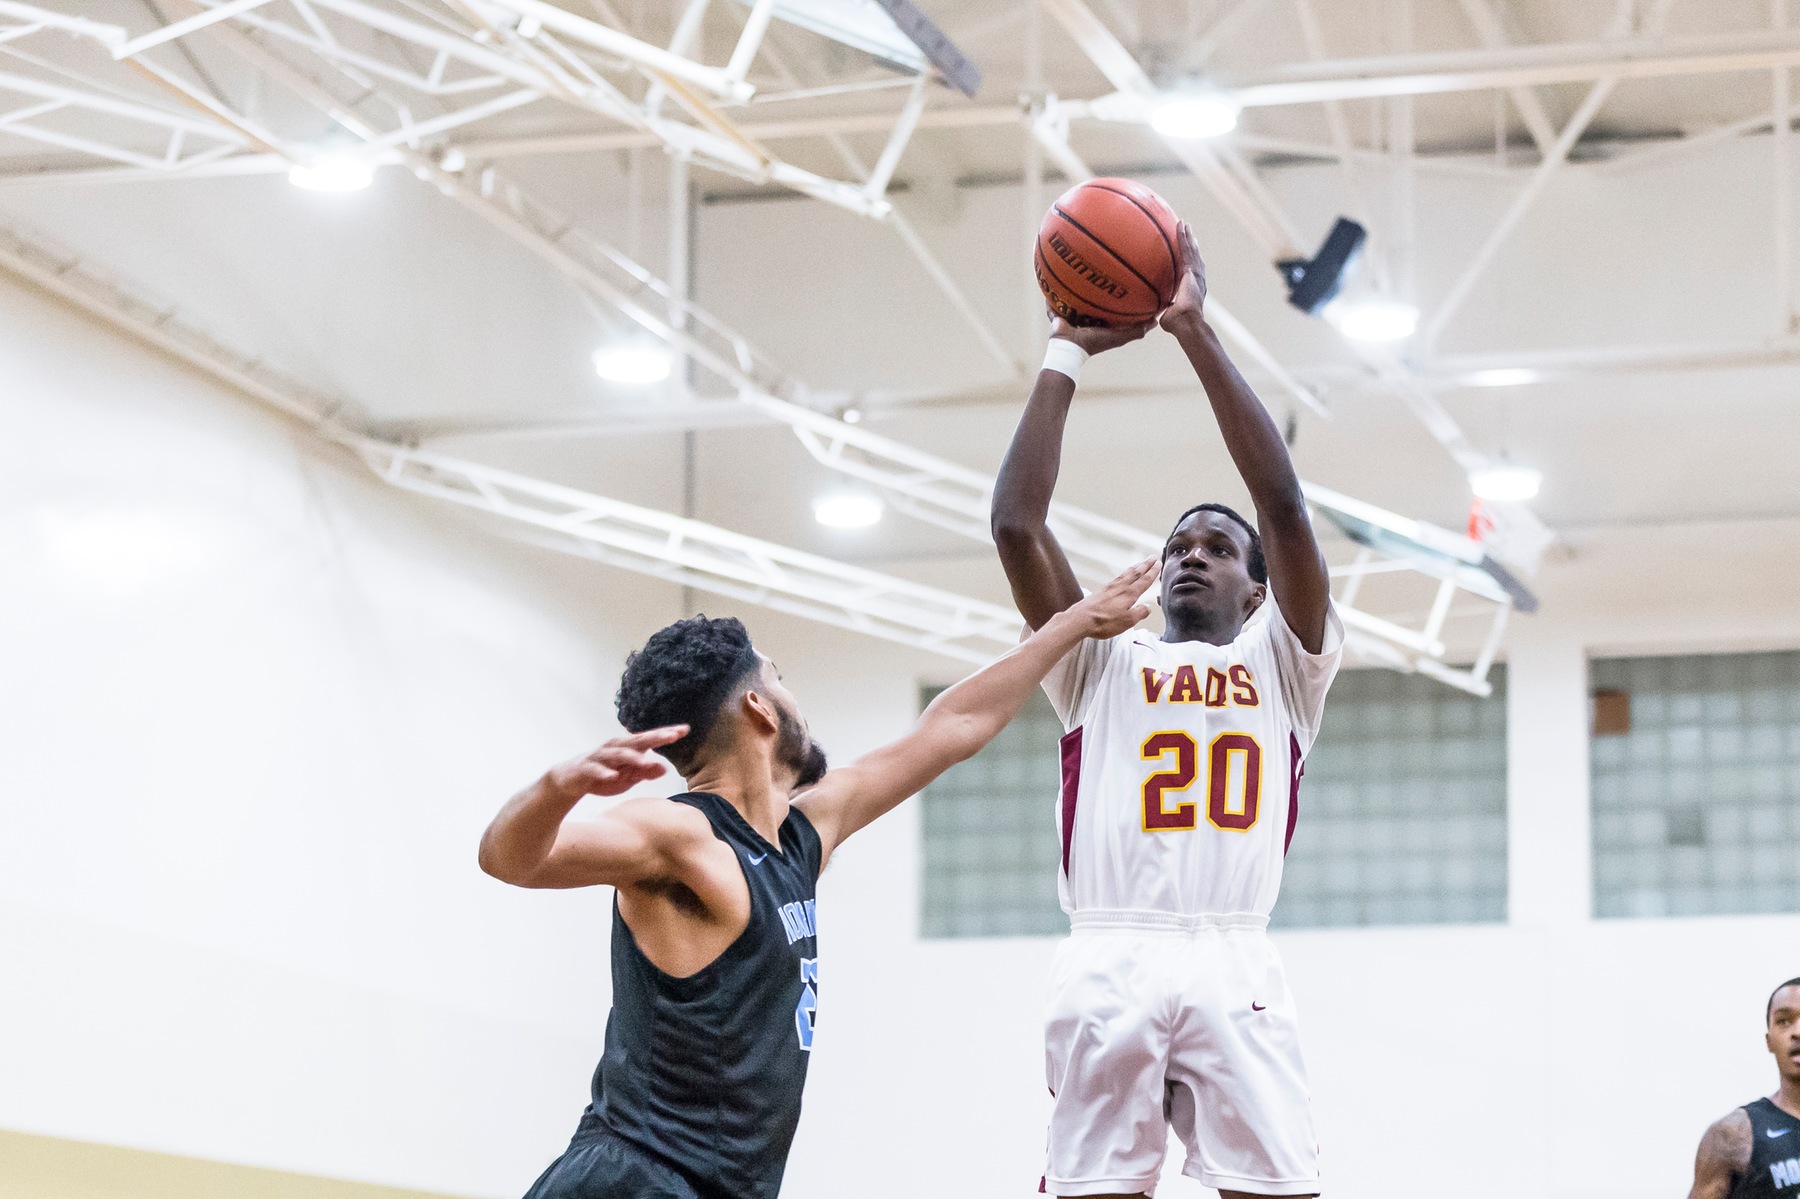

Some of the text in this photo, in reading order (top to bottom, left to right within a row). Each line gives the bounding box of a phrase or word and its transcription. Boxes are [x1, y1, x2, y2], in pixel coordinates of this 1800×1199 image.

[1048, 231, 1129, 299] EVOLUTION
[1140, 729, 1263, 833] 20
[1769, 1157, 1800, 1189] MO
